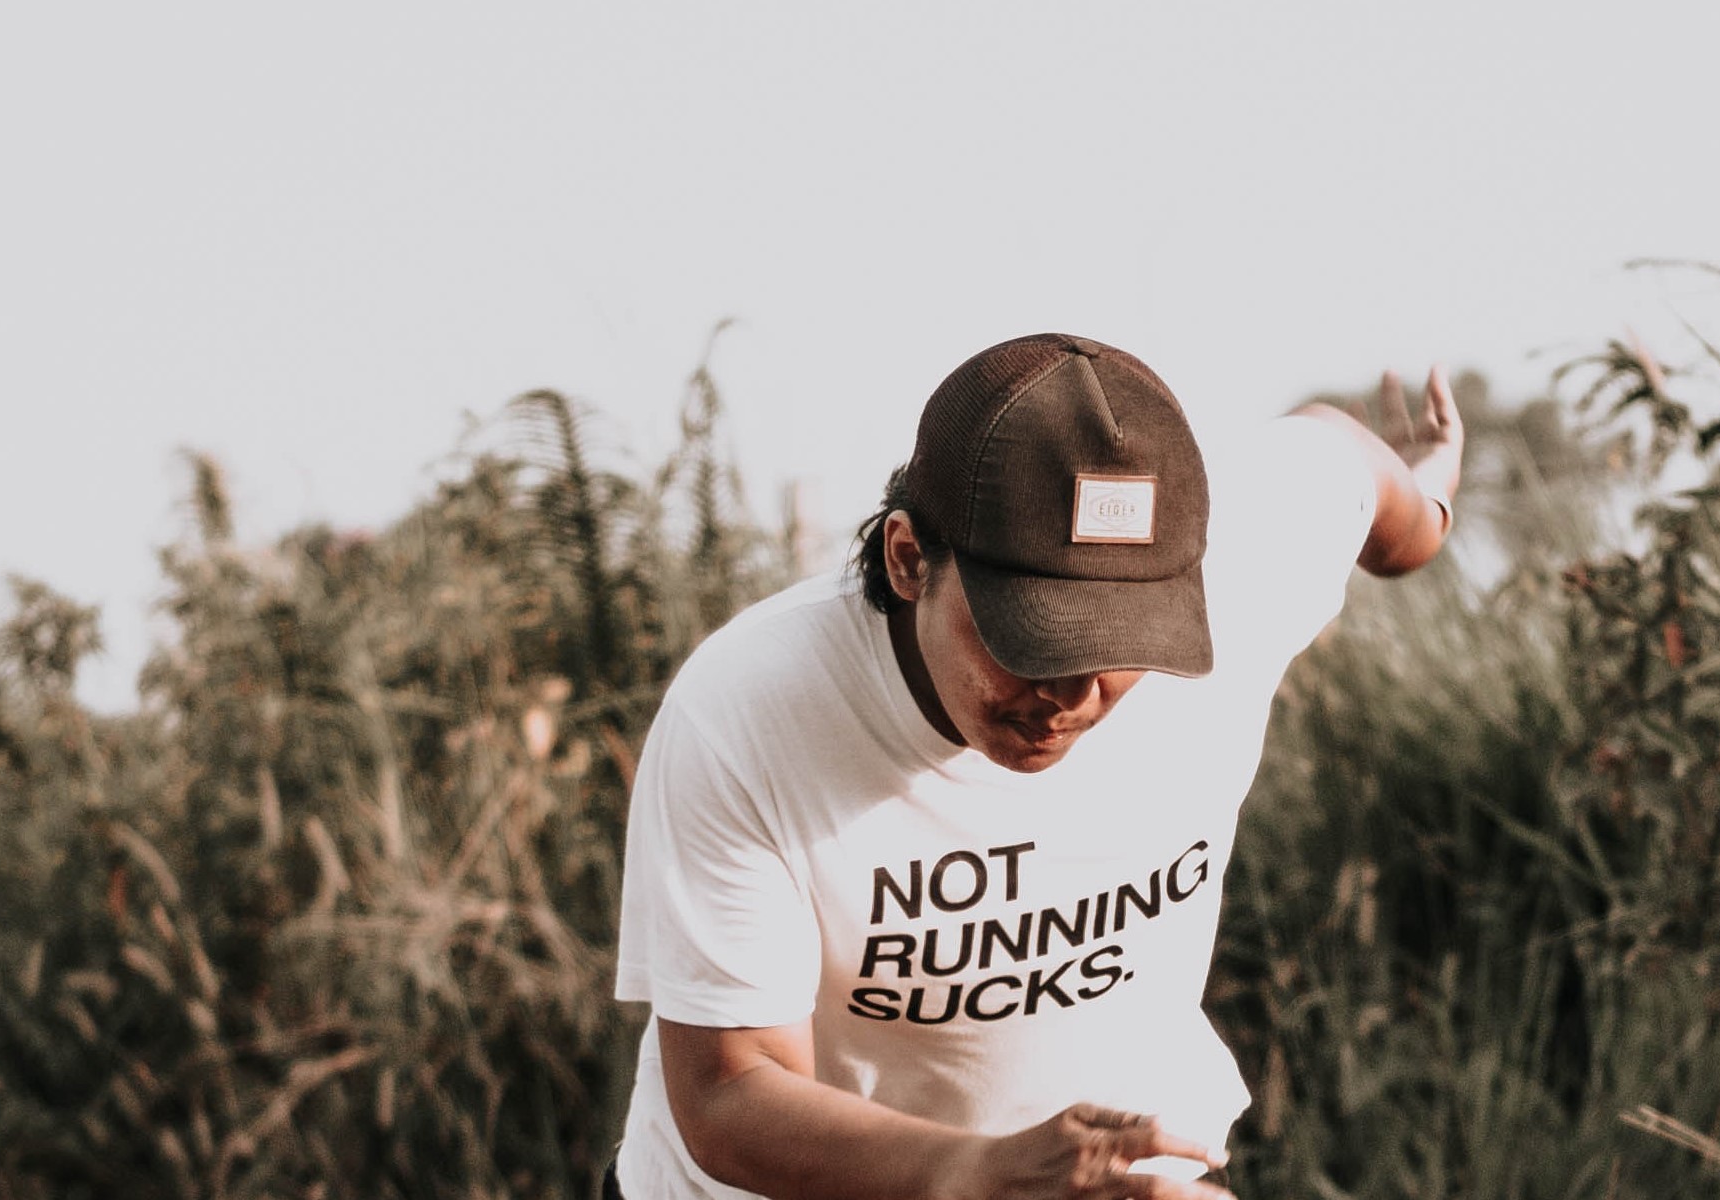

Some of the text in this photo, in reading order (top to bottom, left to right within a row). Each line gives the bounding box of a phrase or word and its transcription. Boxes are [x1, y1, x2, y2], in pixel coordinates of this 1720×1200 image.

[859, 840, 1209, 979] RUNNING
[870, 841, 1036, 925] NOT
[847, 945, 1135, 1025] SUCKS.
